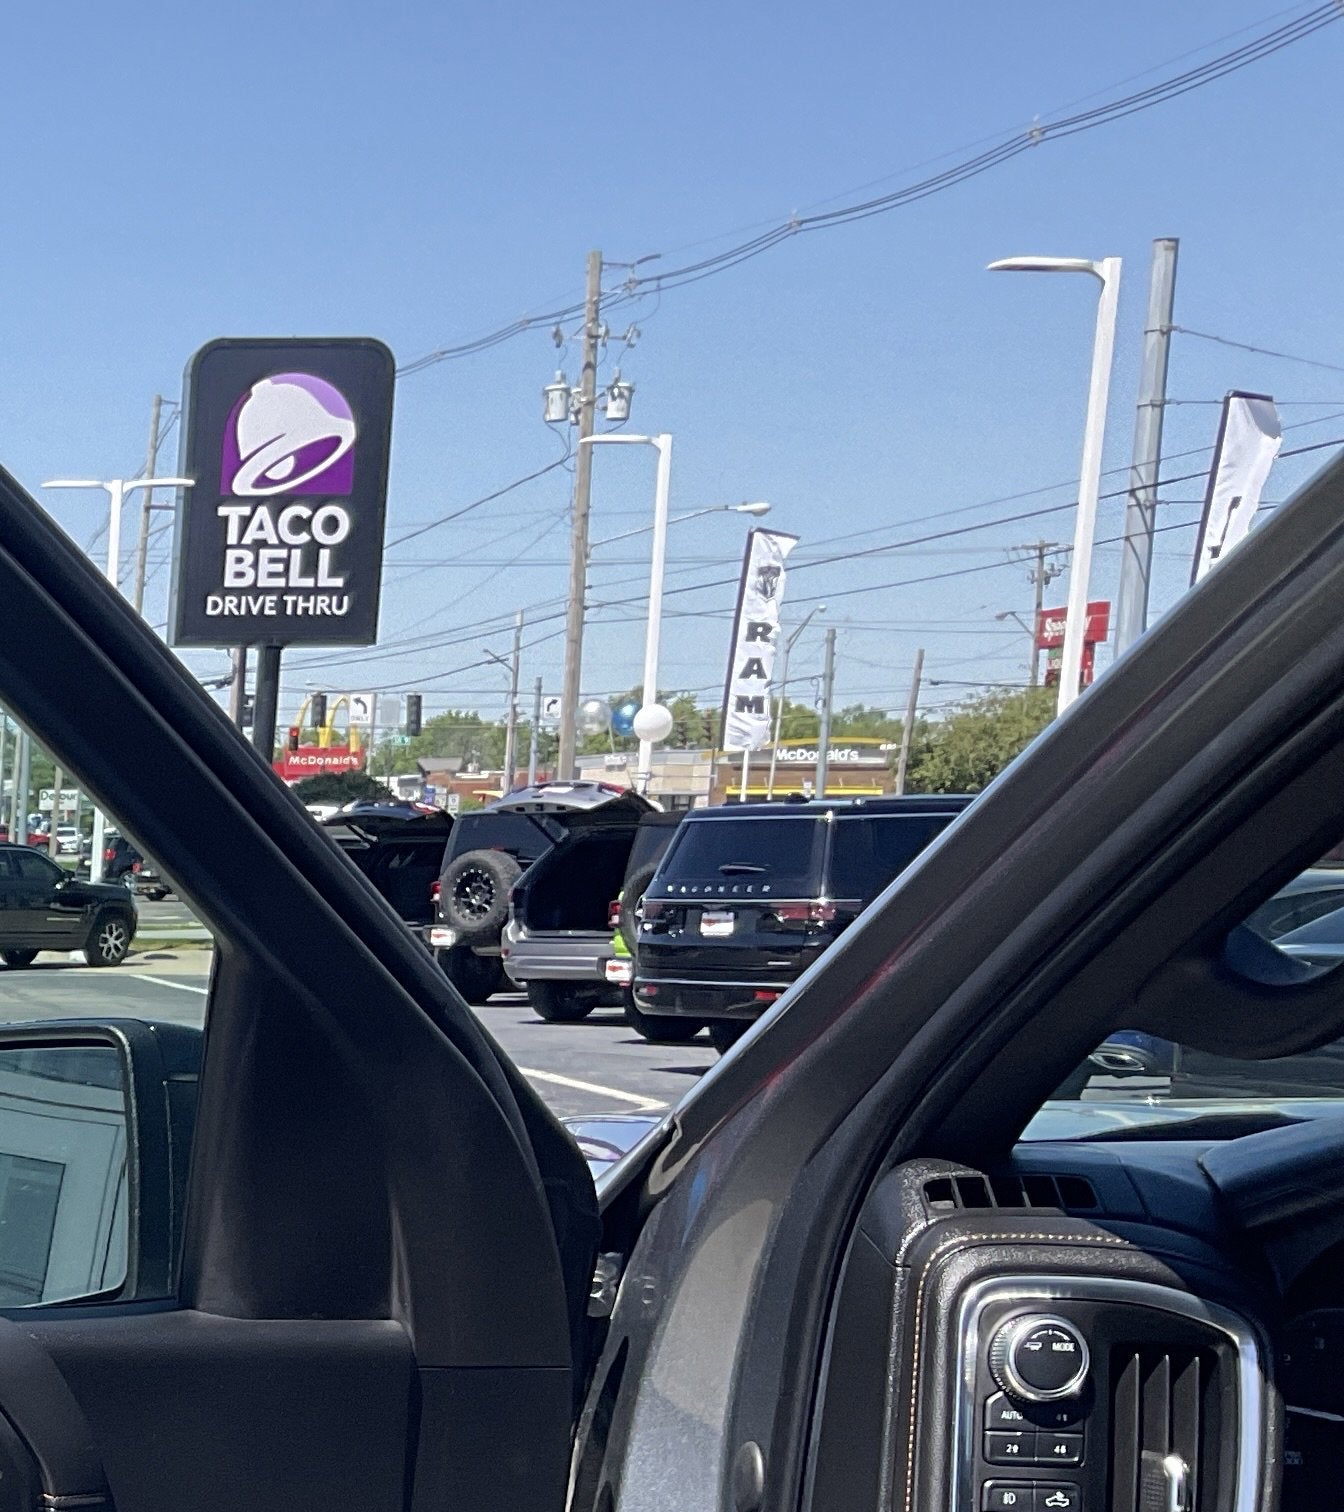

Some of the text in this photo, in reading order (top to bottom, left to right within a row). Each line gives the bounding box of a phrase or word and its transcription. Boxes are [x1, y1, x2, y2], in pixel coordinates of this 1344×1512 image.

[218, 505, 350, 546] TACO
[223, 548, 345, 588] BELL
[206, 595, 349, 616] DRIVE THRU
[735, 621, 773, 714] RAM
[288, 755, 359, 767] McDonald's
[776, 748, 859, 761] McDoald's
[41, 791, 78, 801] Deour
[1052, 1342, 1075, 1352] MODE
